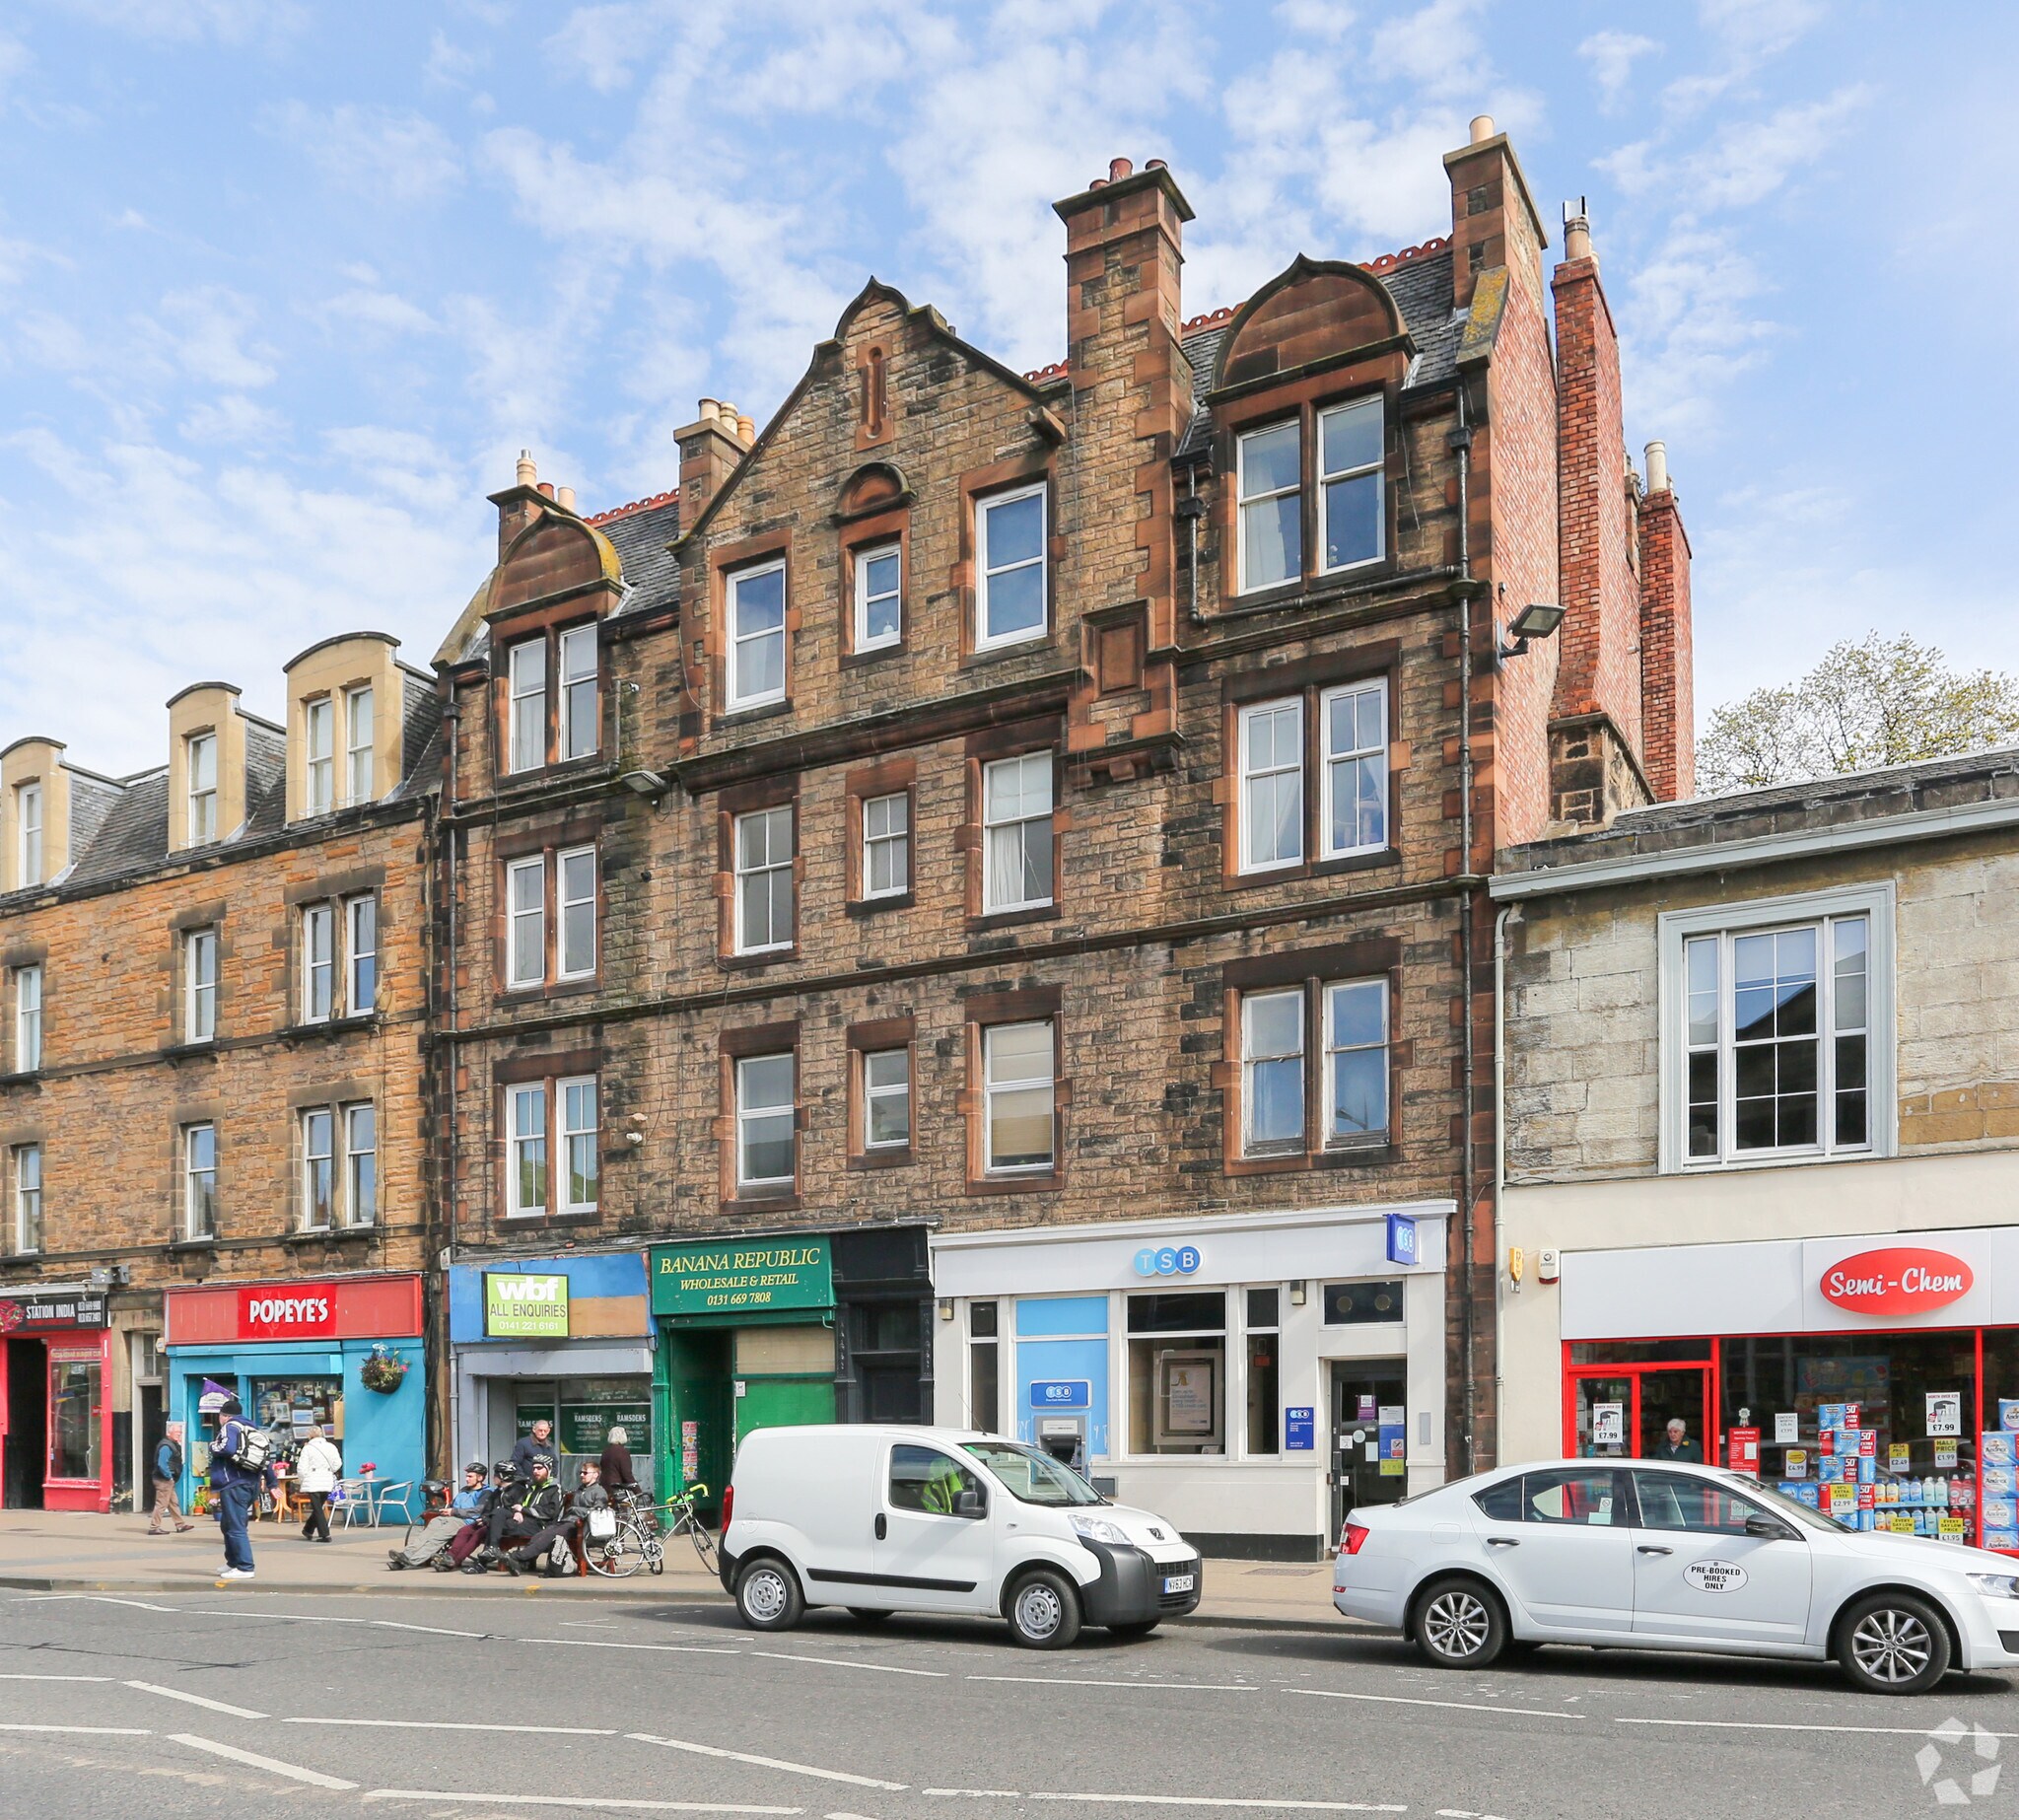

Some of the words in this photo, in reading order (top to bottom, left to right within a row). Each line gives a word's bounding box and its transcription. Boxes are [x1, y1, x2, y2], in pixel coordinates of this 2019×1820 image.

[660, 1253, 730, 1275] BANANA
[732, 1247, 821, 1270] REPUBLIC
[1139, 1249, 1196, 1272] TSB
[496, 1276, 559, 1301] wbf
[680, 1276, 748, 1291] WHOLESALE
[749, 1275, 759, 1287] &
[759, 1273, 800, 1287] RETAIL
[707, 1295, 728, 1306] 0131
[731, 1294, 747, 1304] 669
[749, 1292, 772, 1303] 7808
[26, 1304, 54, 1319] STATION
[55, 1303, 76, 1318] INDIA
[249, 1297, 328, 1323] POPEYE'S
[490, 1303, 509, 1316] ALL
[513, 1303, 566, 1317] ENQUIRIES
[574, 1414, 602, 1423] RAMSDENS
[1691, 1566, 1741, 1575] PRE-BOOKED
